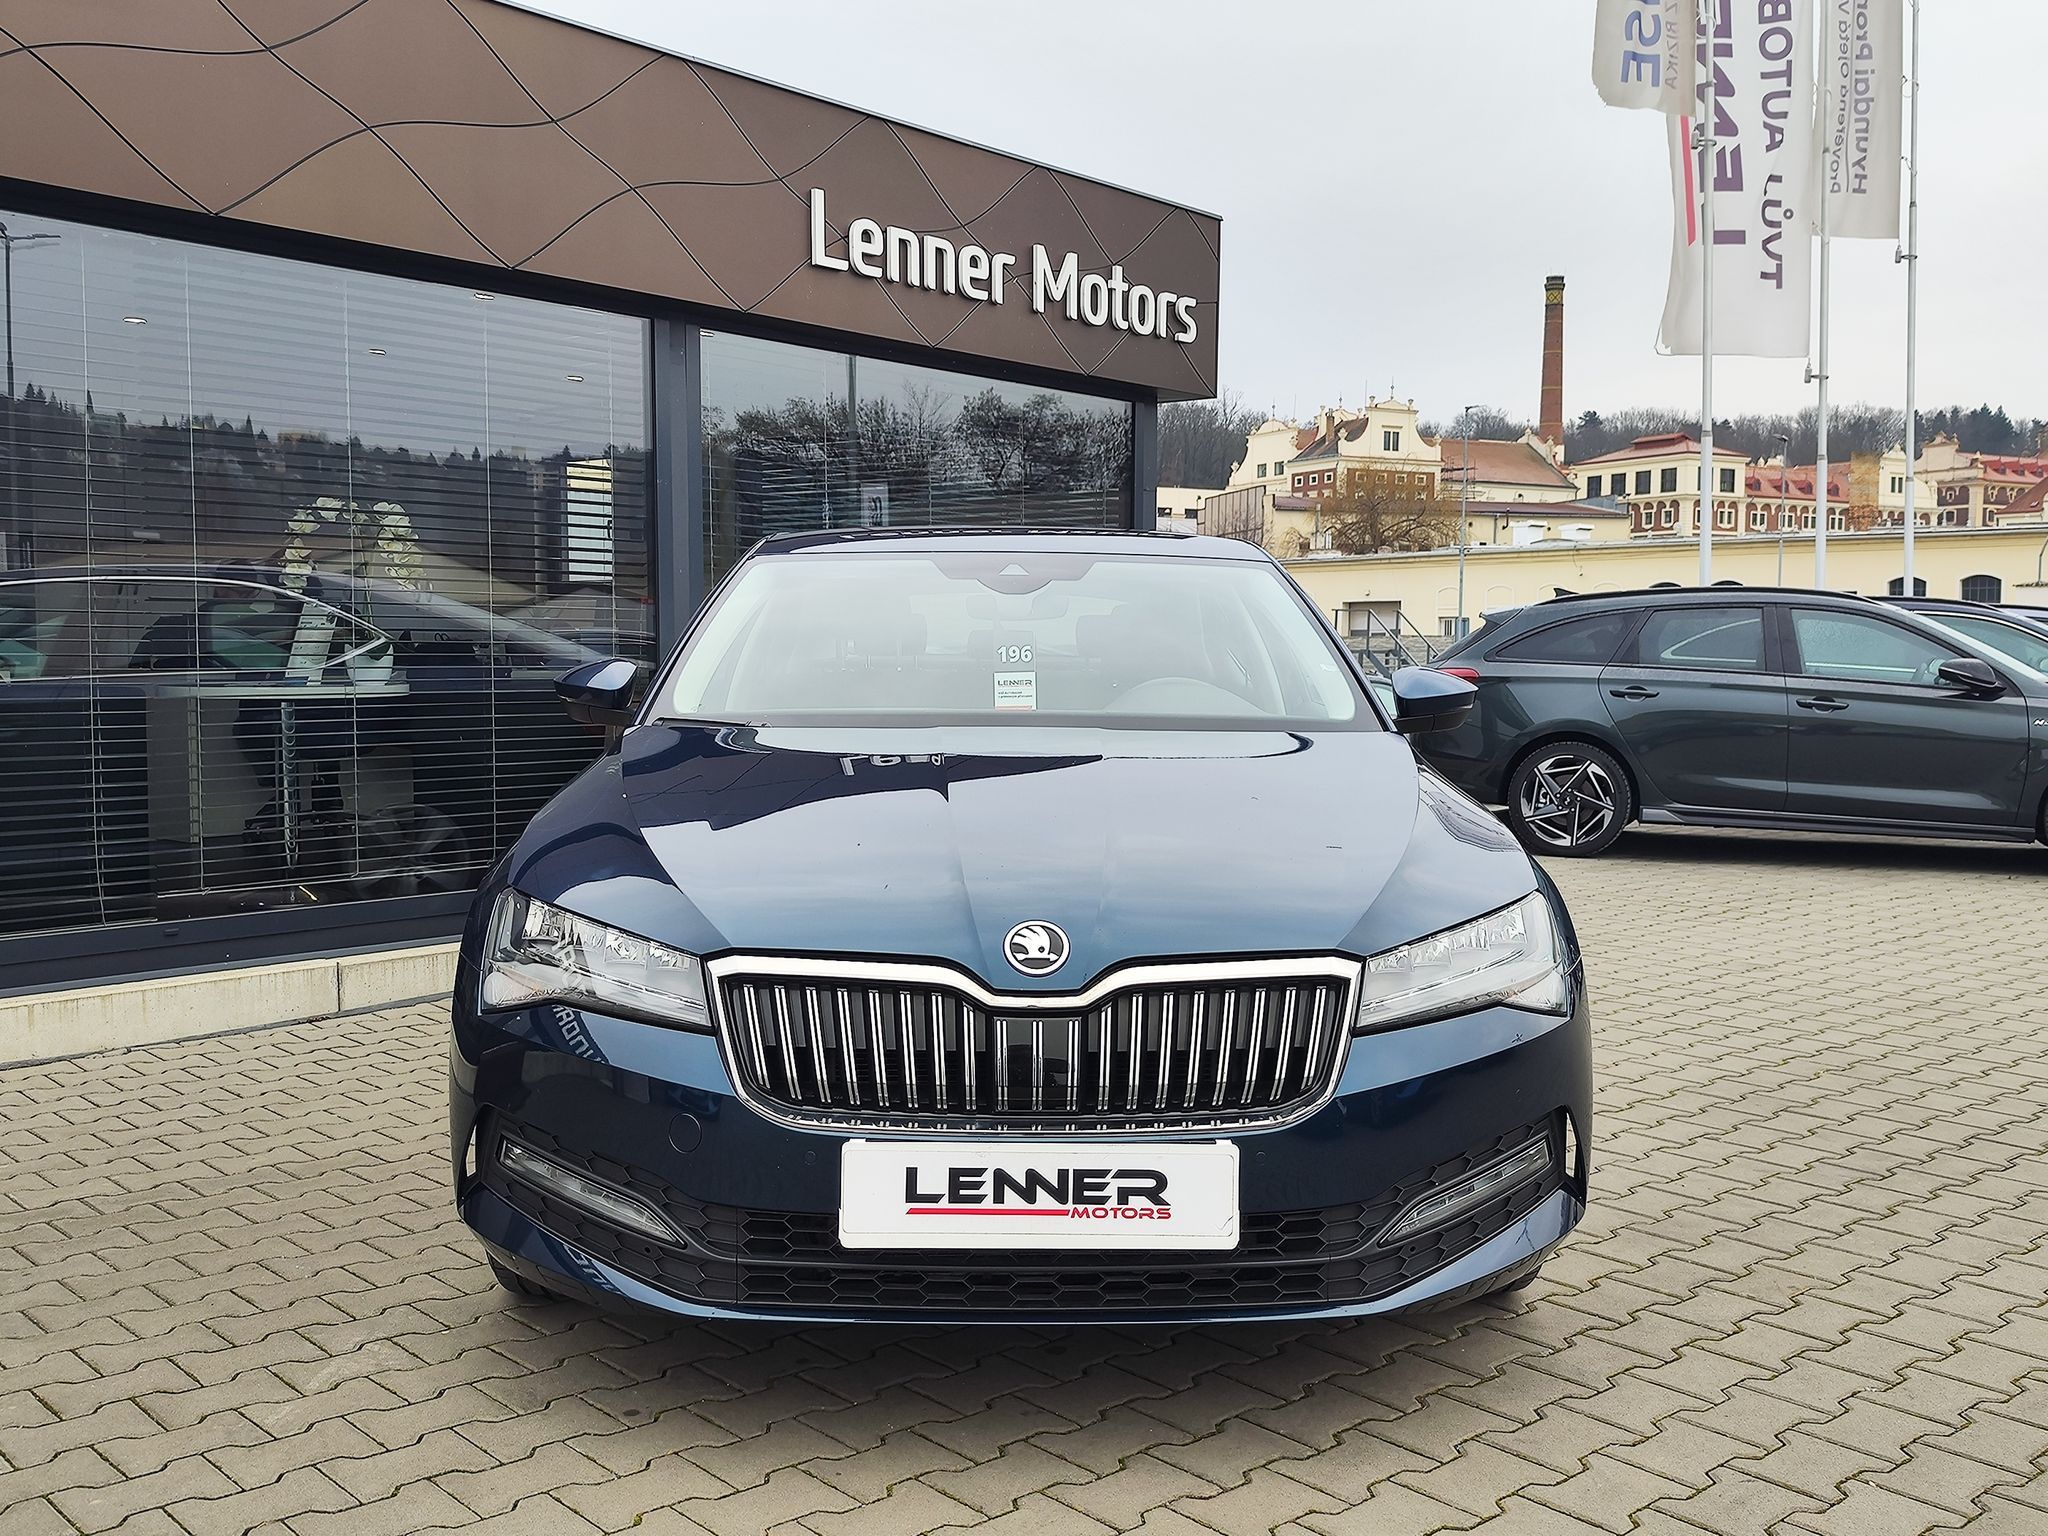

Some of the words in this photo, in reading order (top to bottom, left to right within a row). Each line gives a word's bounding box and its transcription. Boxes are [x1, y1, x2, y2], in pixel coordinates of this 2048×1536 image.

[810, 187, 1015, 304] Lenner
[1031, 243, 1198, 343] Motors
[996, 645, 1033, 663] 196
[905, 1166, 1171, 1206] LENNER
[1070, 1207, 1172, 1219] MOTORS
